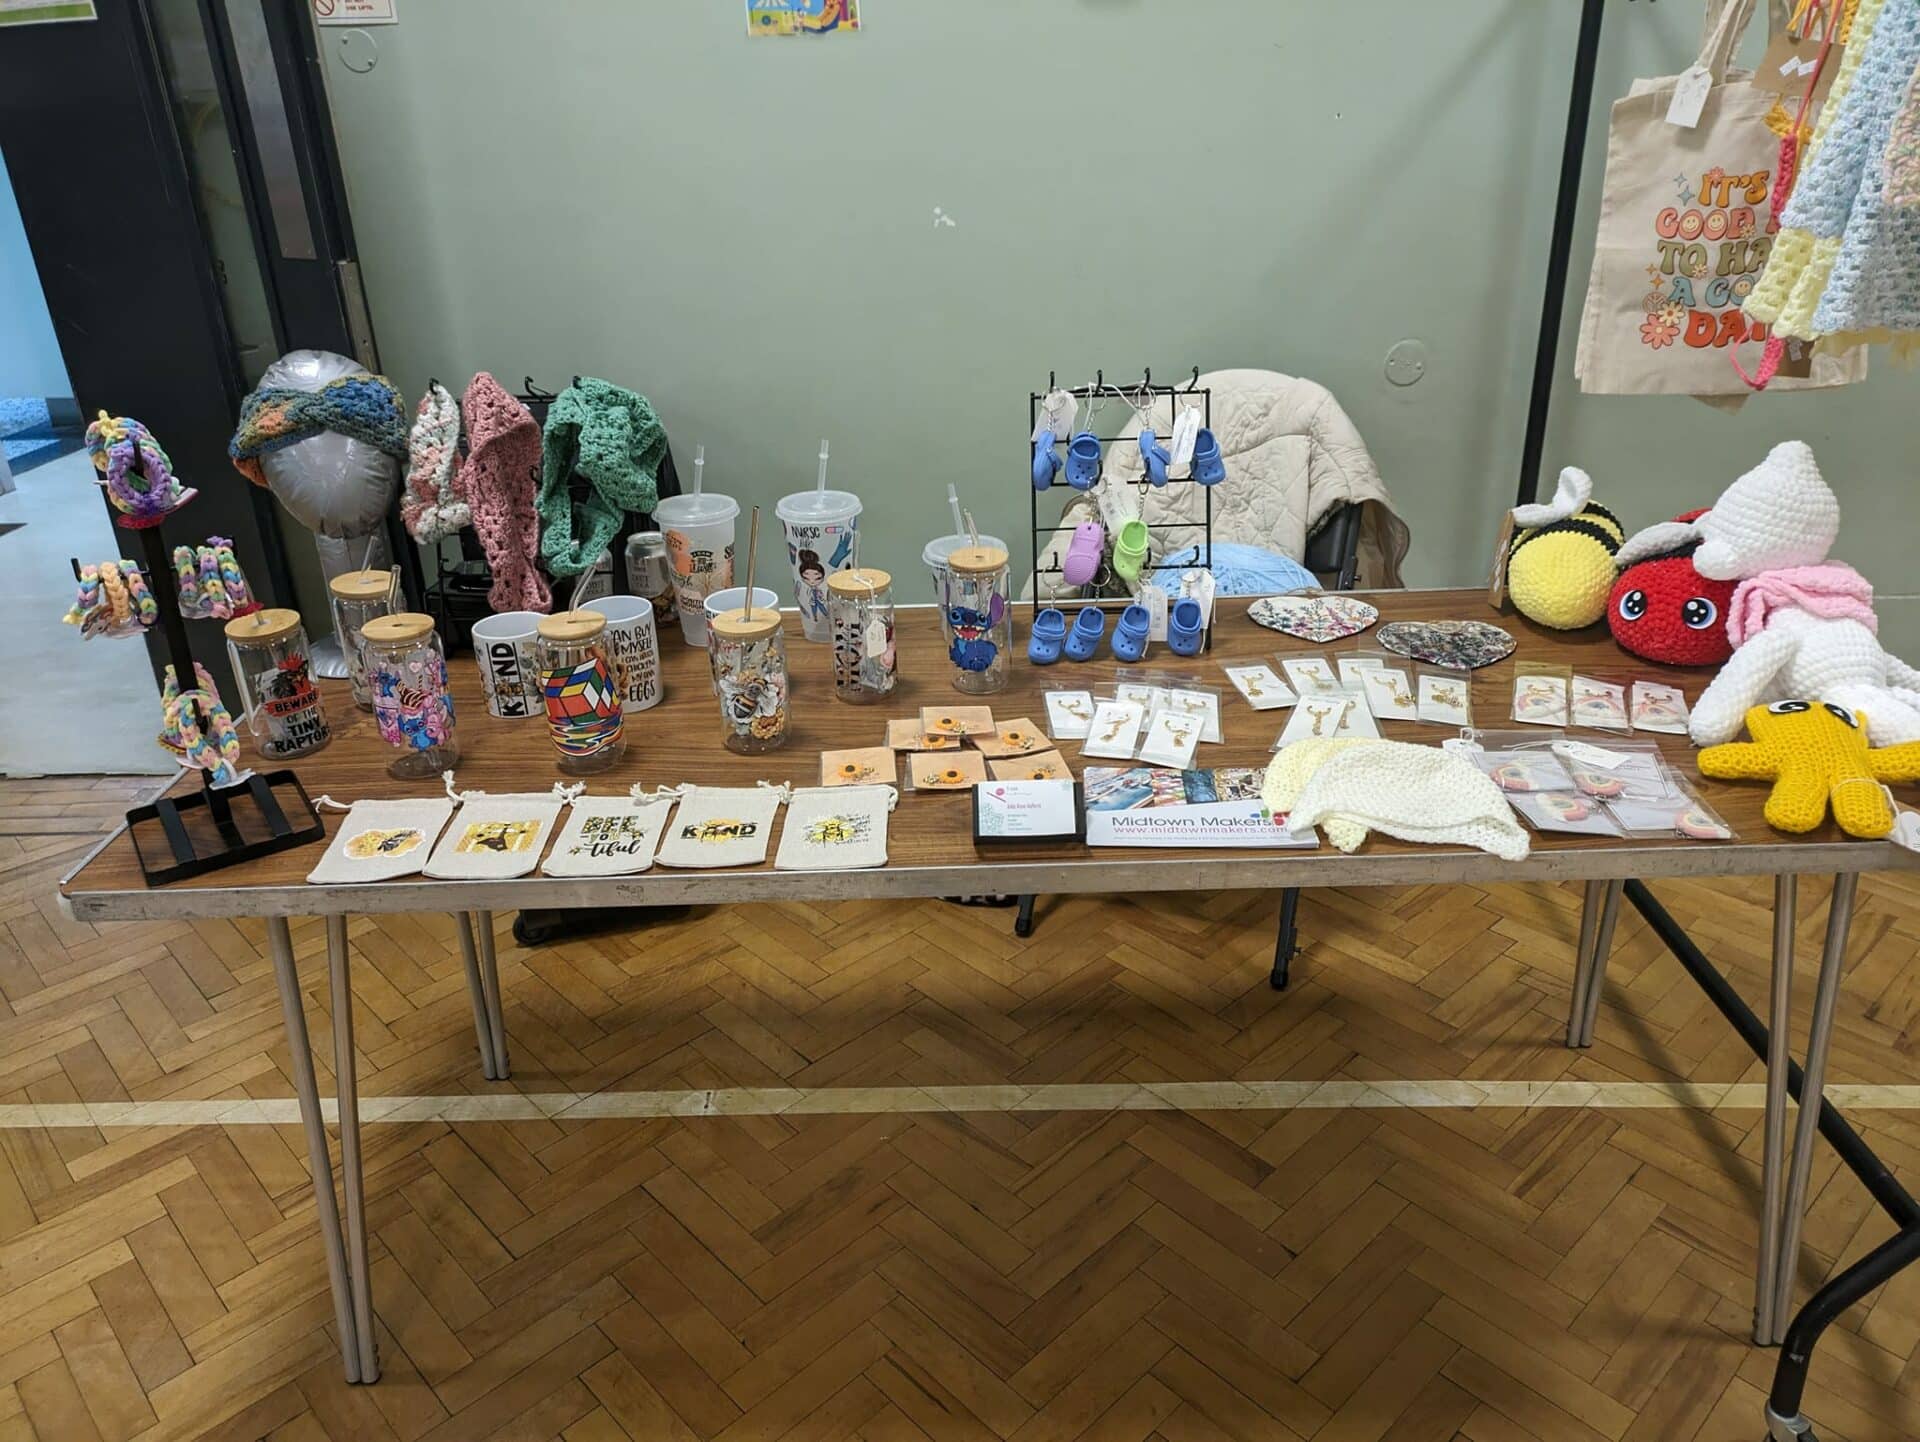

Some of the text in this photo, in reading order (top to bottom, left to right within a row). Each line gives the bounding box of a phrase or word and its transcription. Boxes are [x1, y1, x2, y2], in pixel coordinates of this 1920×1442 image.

[1697, 170, 1770, 208] IT'S
[1655, 207, 1755, 240] GOOD
[1657, 237, 1773, 277] TO HA
[1668, 274, 1756, 308] A GO
[611, 622, 652, 644] AN BUY
[490, 642, 525, 716] KND
[629, 680, 656, 703] EGGS
[288, 715, 320, 737] TINY
[681, 824, 757, 838] KND
[1111, 816, 1272, 827] Midtown Makers
